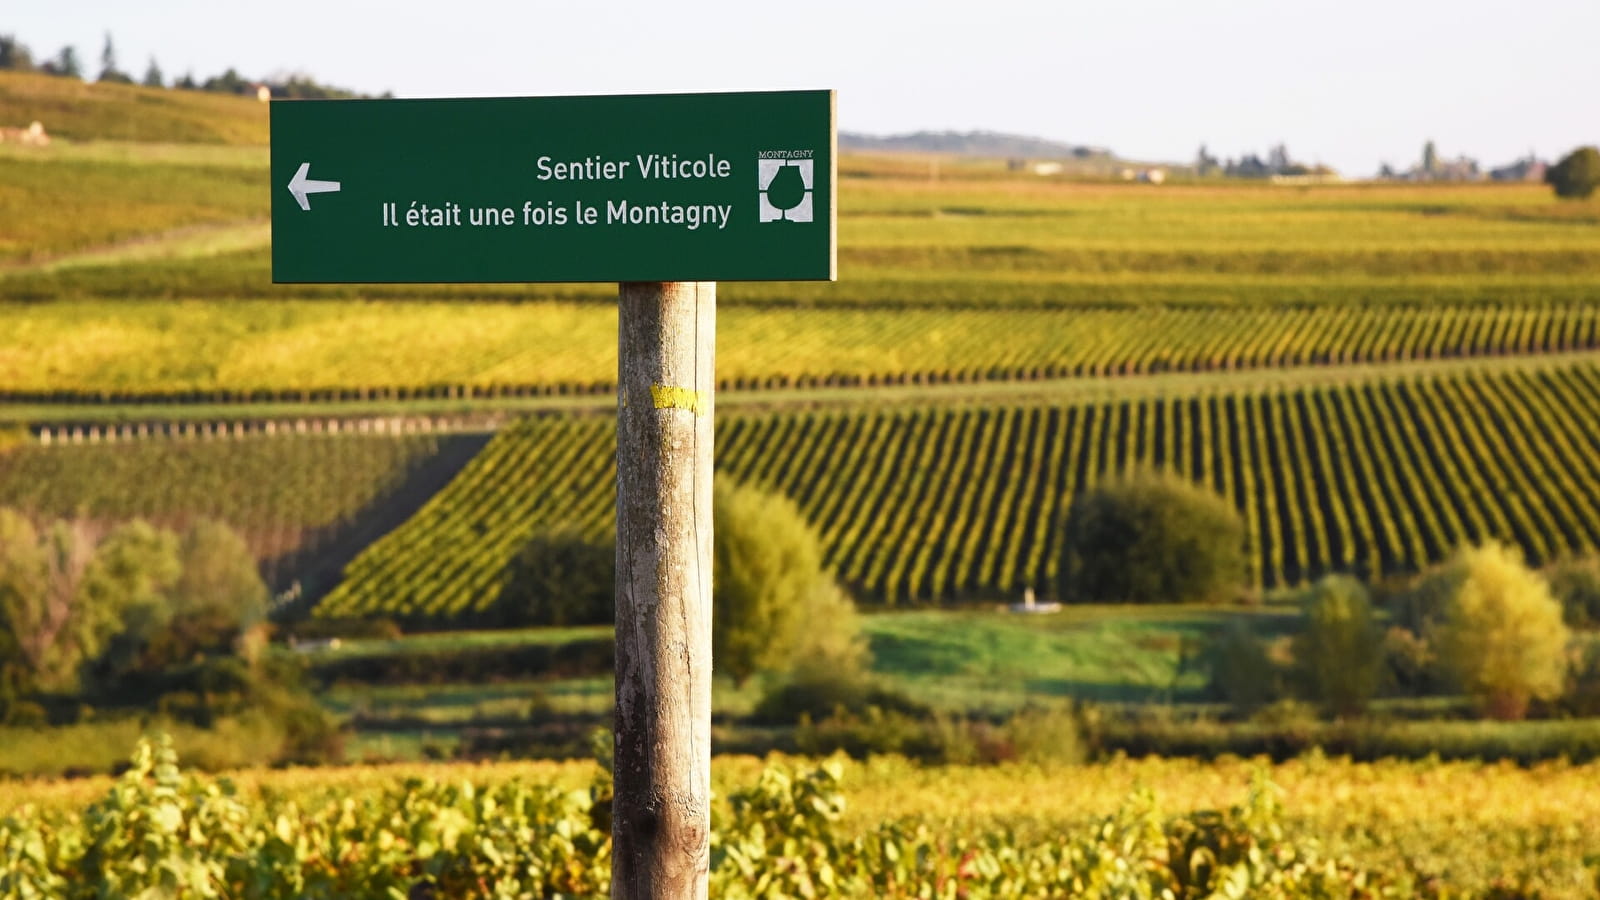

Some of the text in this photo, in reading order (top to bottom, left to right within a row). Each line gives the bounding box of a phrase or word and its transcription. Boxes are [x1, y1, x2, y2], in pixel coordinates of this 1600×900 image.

[536, 153, 731, 181] Sentier Viticole
[758, 150, 814, 159] MONTAGNY
[383, 200, 732, 230] Il était une fois le Montagny
